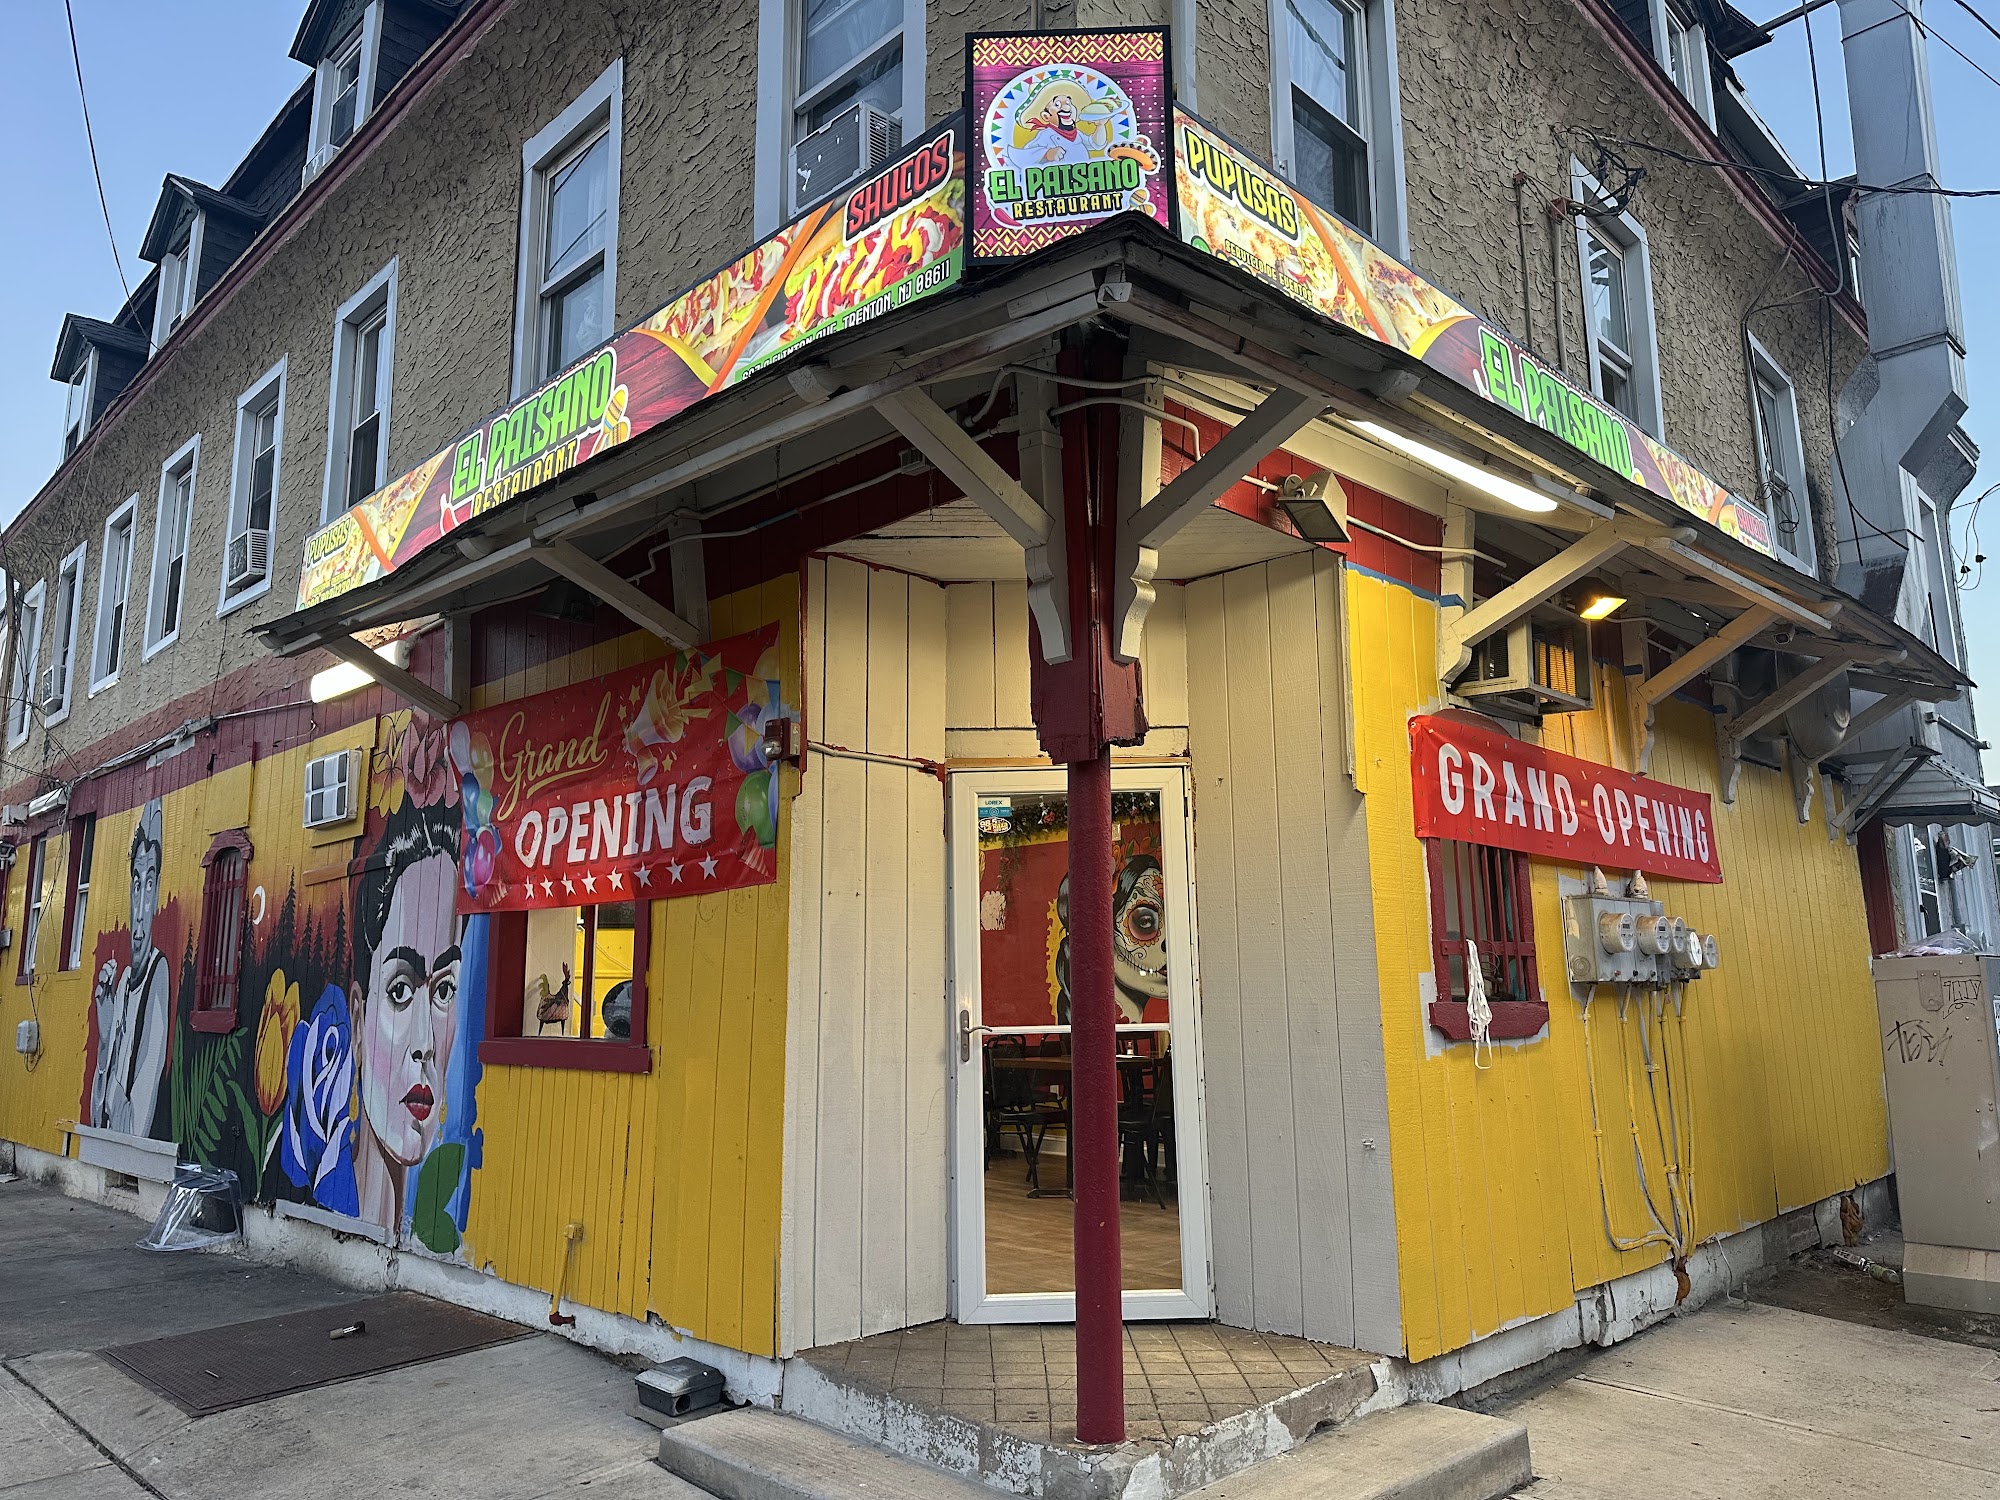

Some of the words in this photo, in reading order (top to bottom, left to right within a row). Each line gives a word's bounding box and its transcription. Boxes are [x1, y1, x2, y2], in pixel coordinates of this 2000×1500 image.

[847, 137, 951, 236] SHUCOS
[988, 170, 1022, 202] EL
[1026, 159, 1139, 199] PAISANO
[1012, 193, 1123, 220] RESTAURANT
[1185, 128, 1299, 241] PUPUSAS
[898, 282, 912, 304] NJ
[916, 259, 950, 294] 08611
[452, 432, 482, 505] EL
[486, 350, 614, 485] PAISANO
[1481, 329, 1524, 414] EL
[1521, 356, 1633, 479] PAISANO
[473, 438, 578, 518] RESTAURANT
[307, 517, 351, 568] PUPUSAS
[497, 691, 612, 821] Grand
[1438, 742, 1579, 836] GRAND
[1592, 783, 1710, 864] OPENING
[515, 775, 713, 869] OPENING
